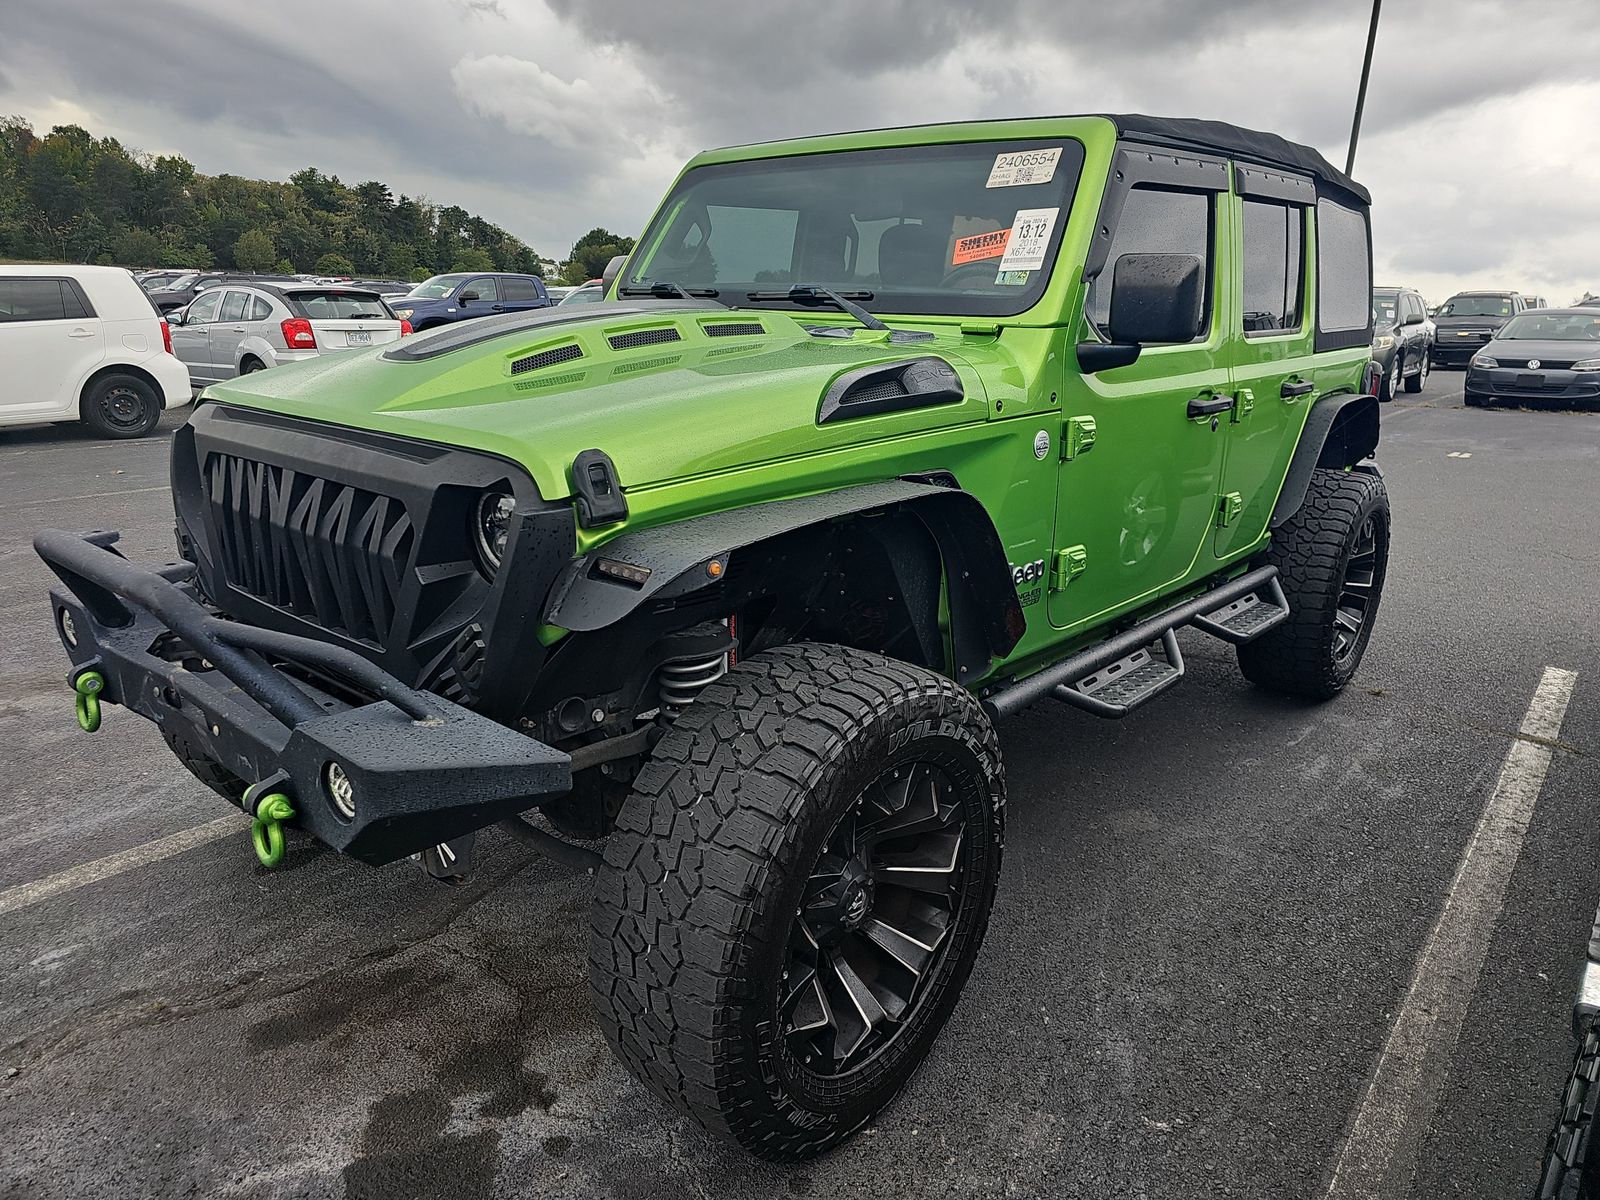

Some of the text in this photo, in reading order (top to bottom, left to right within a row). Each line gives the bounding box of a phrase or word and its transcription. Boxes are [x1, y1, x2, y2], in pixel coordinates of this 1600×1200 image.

[997, 152, 1056, 169] 2406554
[960, 231, 1006, 248] SHEEHY
[1018, 223, 1047, 239] 13:12
[1019, 238, 1038, 247] 2018
[1008, 558, 1046, 587] eep
[887, 718, 997, 785] WILDPEAK
